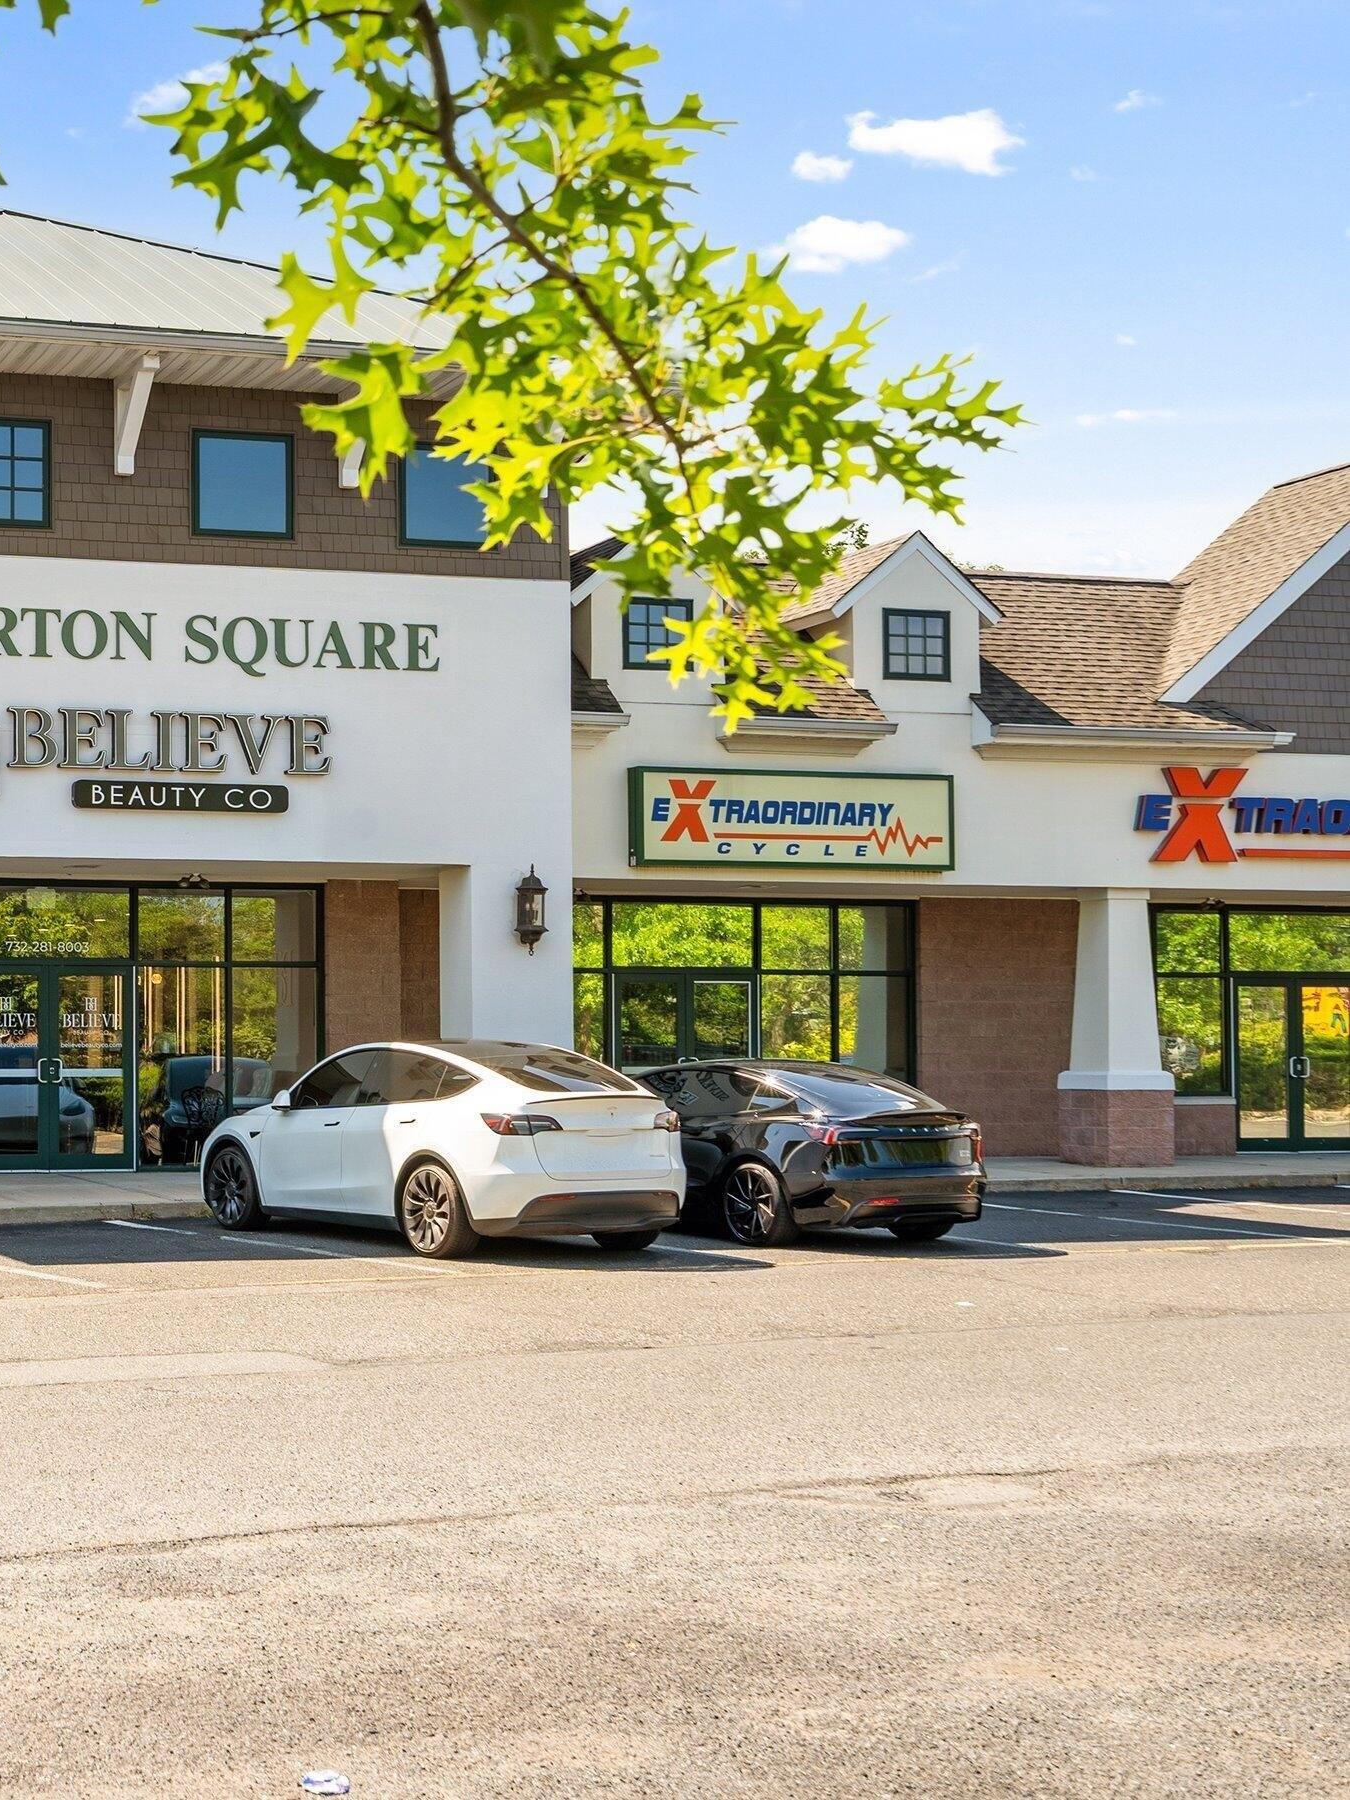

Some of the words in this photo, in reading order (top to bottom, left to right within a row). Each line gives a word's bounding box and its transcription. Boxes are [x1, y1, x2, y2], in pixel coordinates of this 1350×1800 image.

[183, 613, 441, 677] SQUARE
[6, 705, 333, 776] BELIEVE
[91, 784, 207, 809] BEAUTY
[224, 787, 273, 809] CO
[651, 779, 894, 842] EXTRAORDINARY
[717, 842, 868, 857] CYCLE
[5, 941, 90, 953] 732-281-8003
